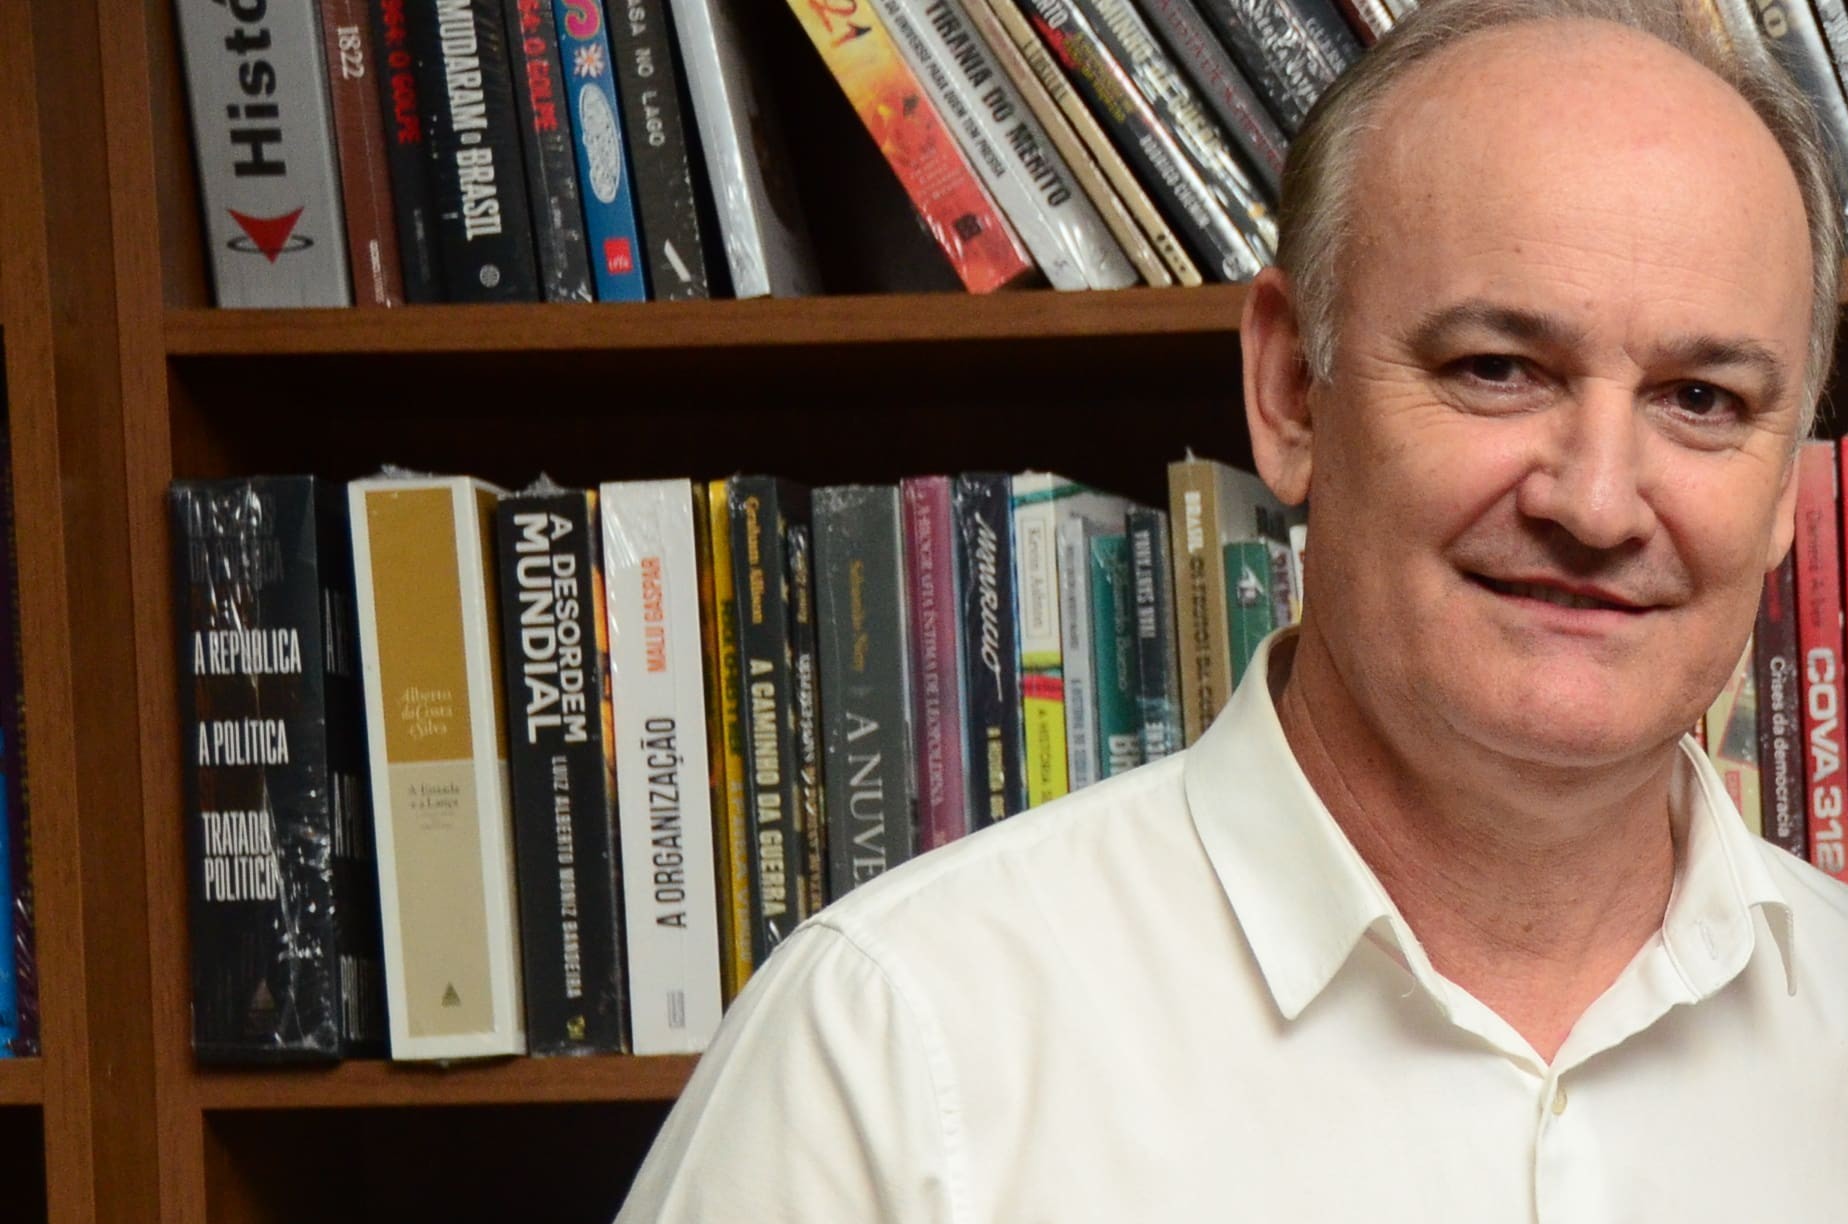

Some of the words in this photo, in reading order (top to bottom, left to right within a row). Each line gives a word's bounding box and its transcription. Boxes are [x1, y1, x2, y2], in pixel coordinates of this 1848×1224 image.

[335, 23, 367, 81] 1822
[437, 0, 488, 131] MUDARAM
[633, 46, 654, 79] NO
[921, 0, 995, 89] TIRANIA
[980, 84, 1018, 125] DO
[639, 89, 666, 148] LAGO
[456, 148, 502, 242] BRASIL
[547, 512, 574, 540] A
[639, 556, 664, 620] GASPAR
[195, 630, 206, 675] A
[511, 510, 555, 745] MUNDIAL
[551, 552, 588, 744] DESORDEM
[645, 621, 668, 674] MALU
[748, 656, 772, 676] A
[1768, 656, 1787, 711] Crises
[199, 721, 210, 767] A
[213, 715, 289, 766] POLÍTICA
[750, 682, 780, 786] CAMINHO
[843, 708, 881, 742] A
[1771, 712, 1788, 735] da
[1805, 646, 1842, 784] COVA
[549, 754, 569, 791] LUIZ
[1773, 736, 1792, 837] democracia
[202, 811, 274, 856] TRATADO
[551, 794, 574, 864] ALBERTO
[646, 716, 687, 900] ORGANIZAÇÃO
[755, 790, 783, 823] DA
[1814, 787, 1846, 873] 312
[759, 829, 787, 918] GUERRA
[655, 910, 687, 930] A
[559, 920, 584, 999] BANDEIRA
